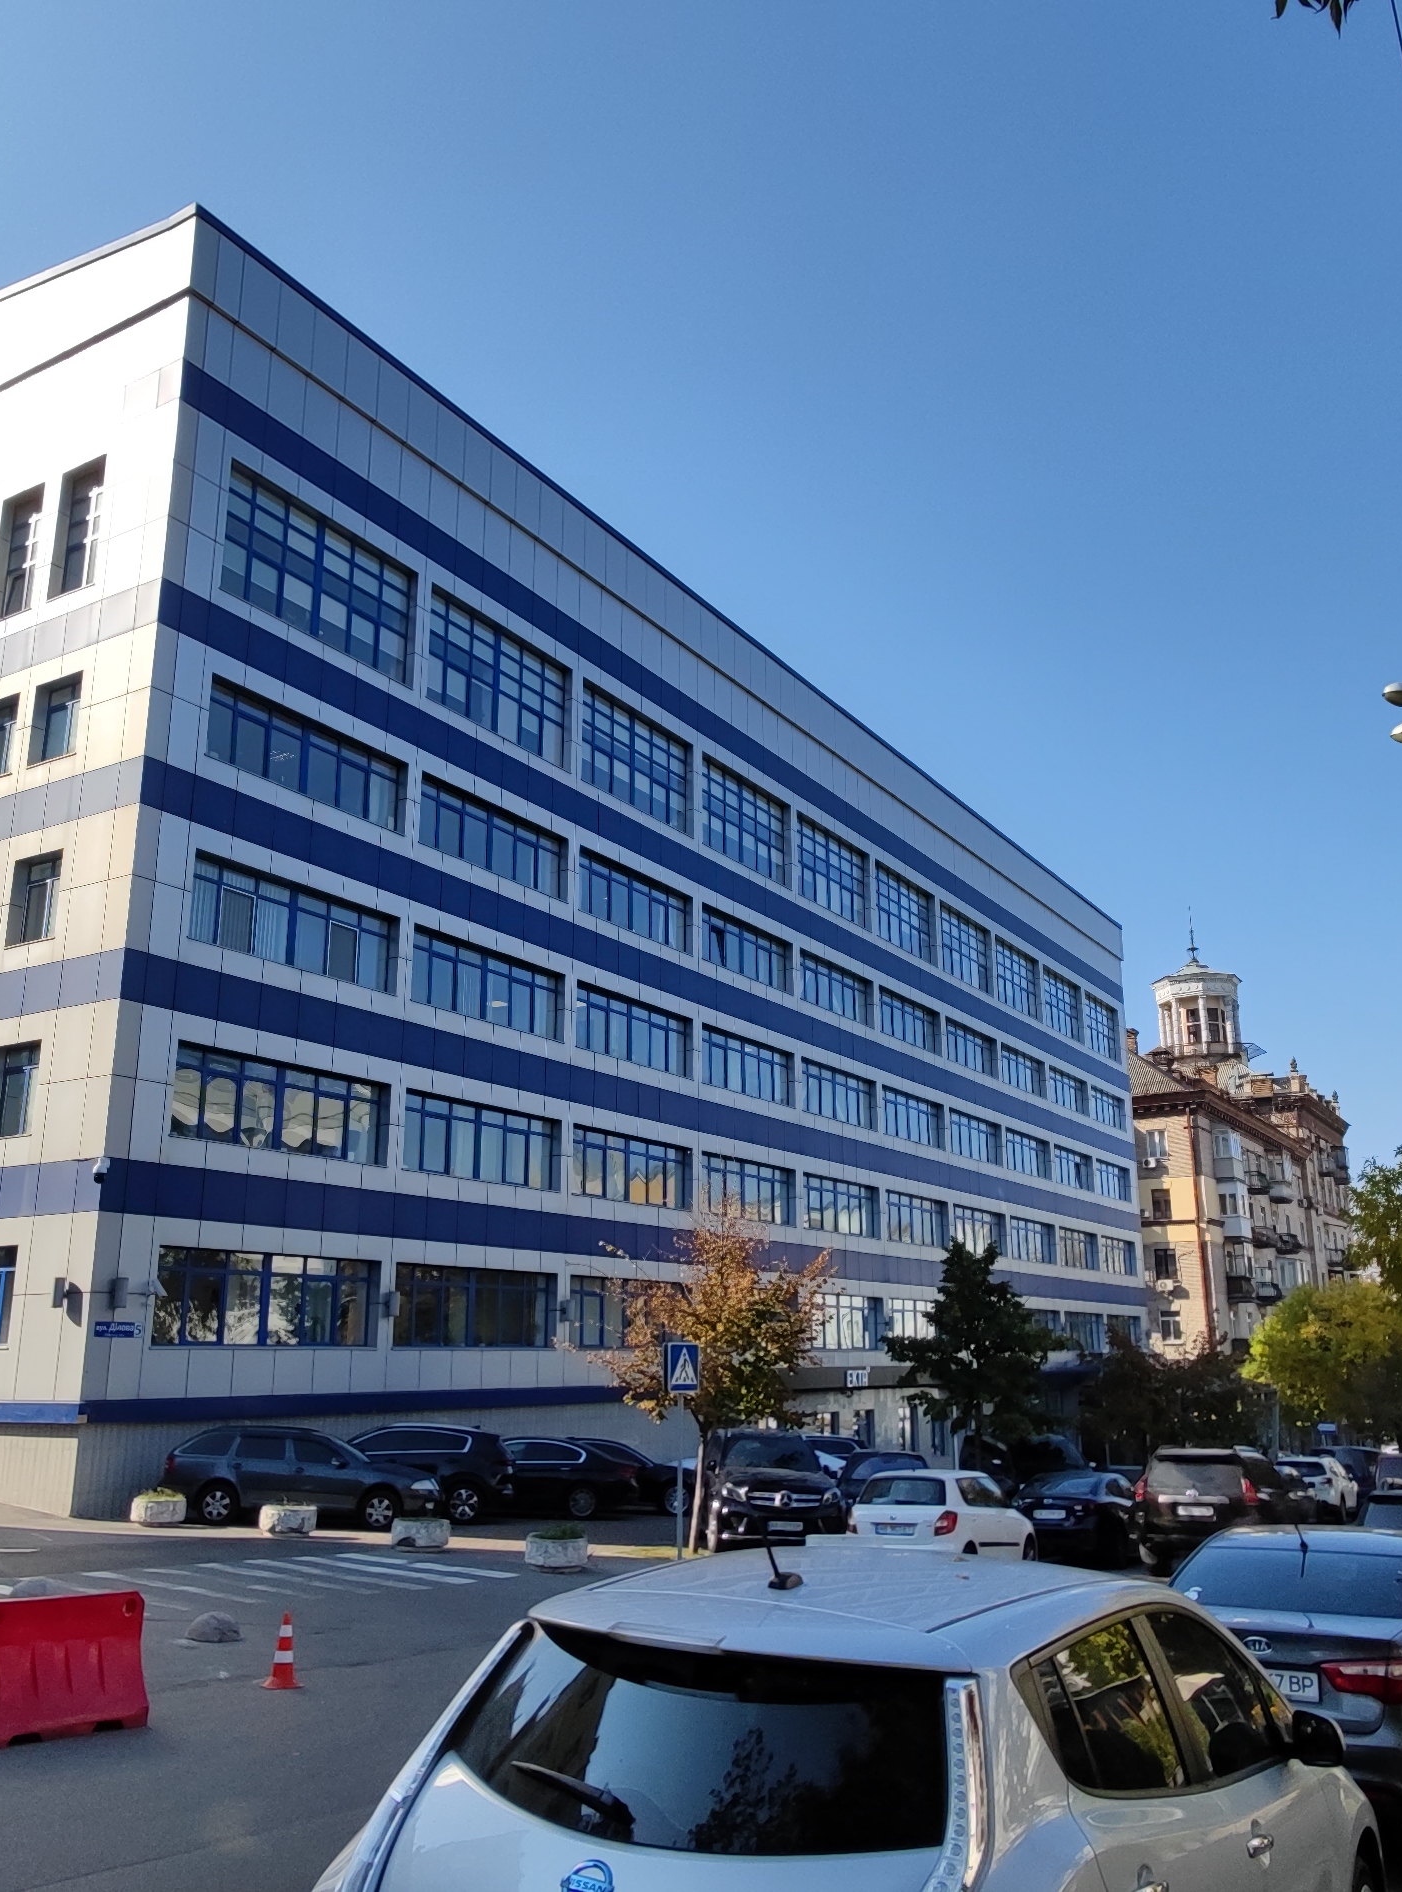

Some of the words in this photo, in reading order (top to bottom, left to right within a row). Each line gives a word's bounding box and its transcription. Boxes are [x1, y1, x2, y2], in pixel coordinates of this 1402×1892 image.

[109, 1322, 135, 1333] Ділова
[135, 1324, 142, 1336] 5
[1289, 1674, 1314, 1693] BP
